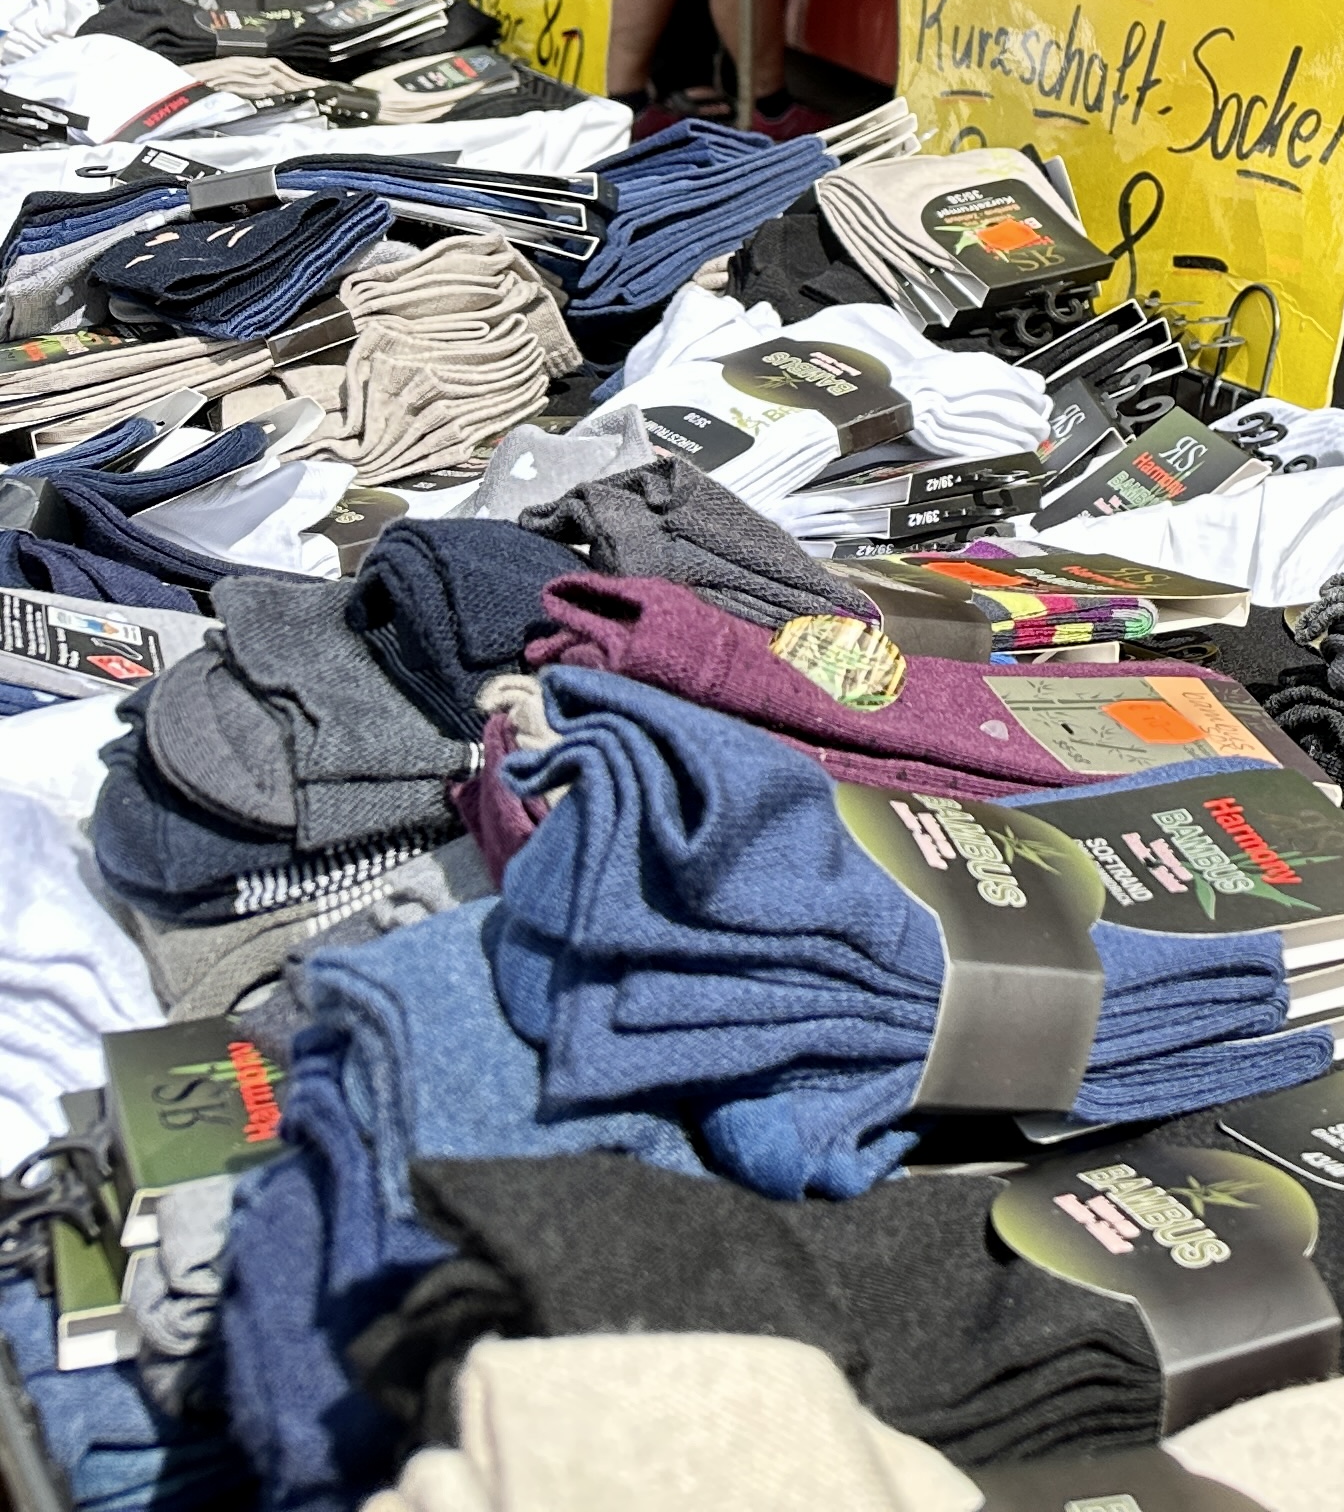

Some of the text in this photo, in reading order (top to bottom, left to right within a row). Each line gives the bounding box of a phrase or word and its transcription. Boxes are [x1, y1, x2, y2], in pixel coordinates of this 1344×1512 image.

[762, 351, 859, 397] BAMBUS
[643, 416, 704, 455] KURZSTRUM
[1131, 450, 1188, 500] Harmony
[907, 509, 941, 528] 39/42
[911, 792, 1028, 908] BAMBUS
[1085, 837, 1154, 903] SOFTRAND
[1151, 808, 1255, 895] BAMBUS
[1204, 797, 1303, 886] Harmony
[1075, 1162, 1233, 1270] BAMBUS
